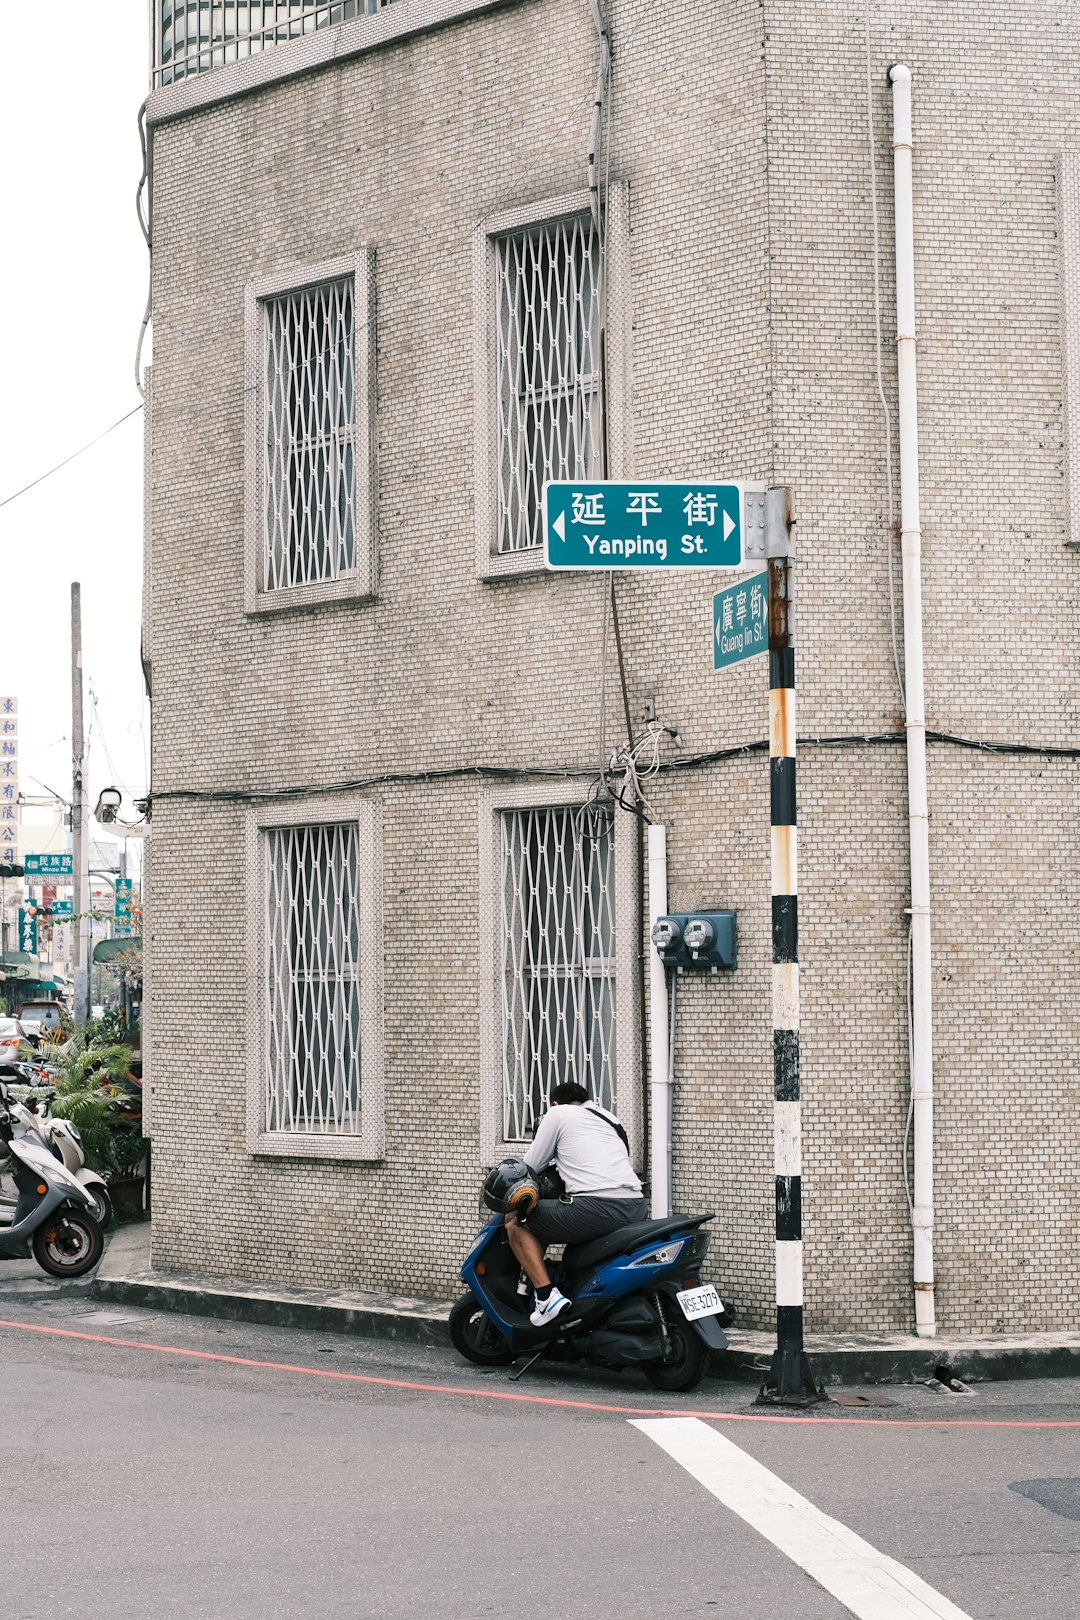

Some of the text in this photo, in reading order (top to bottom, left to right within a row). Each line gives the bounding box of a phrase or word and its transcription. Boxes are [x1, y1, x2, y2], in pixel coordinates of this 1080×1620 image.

[571, 492, 718, 526] 延平街
[583, 534, 708, 560] Yanping St.
[722, 584, 762, 632] 廣寧街
[721, 633, 744, 654] Guang
[754, 622, 763, 642] St.
[2, 698, 15, 862] 東和軸承有限公司
[38, 856, 72, 866] 民族路
